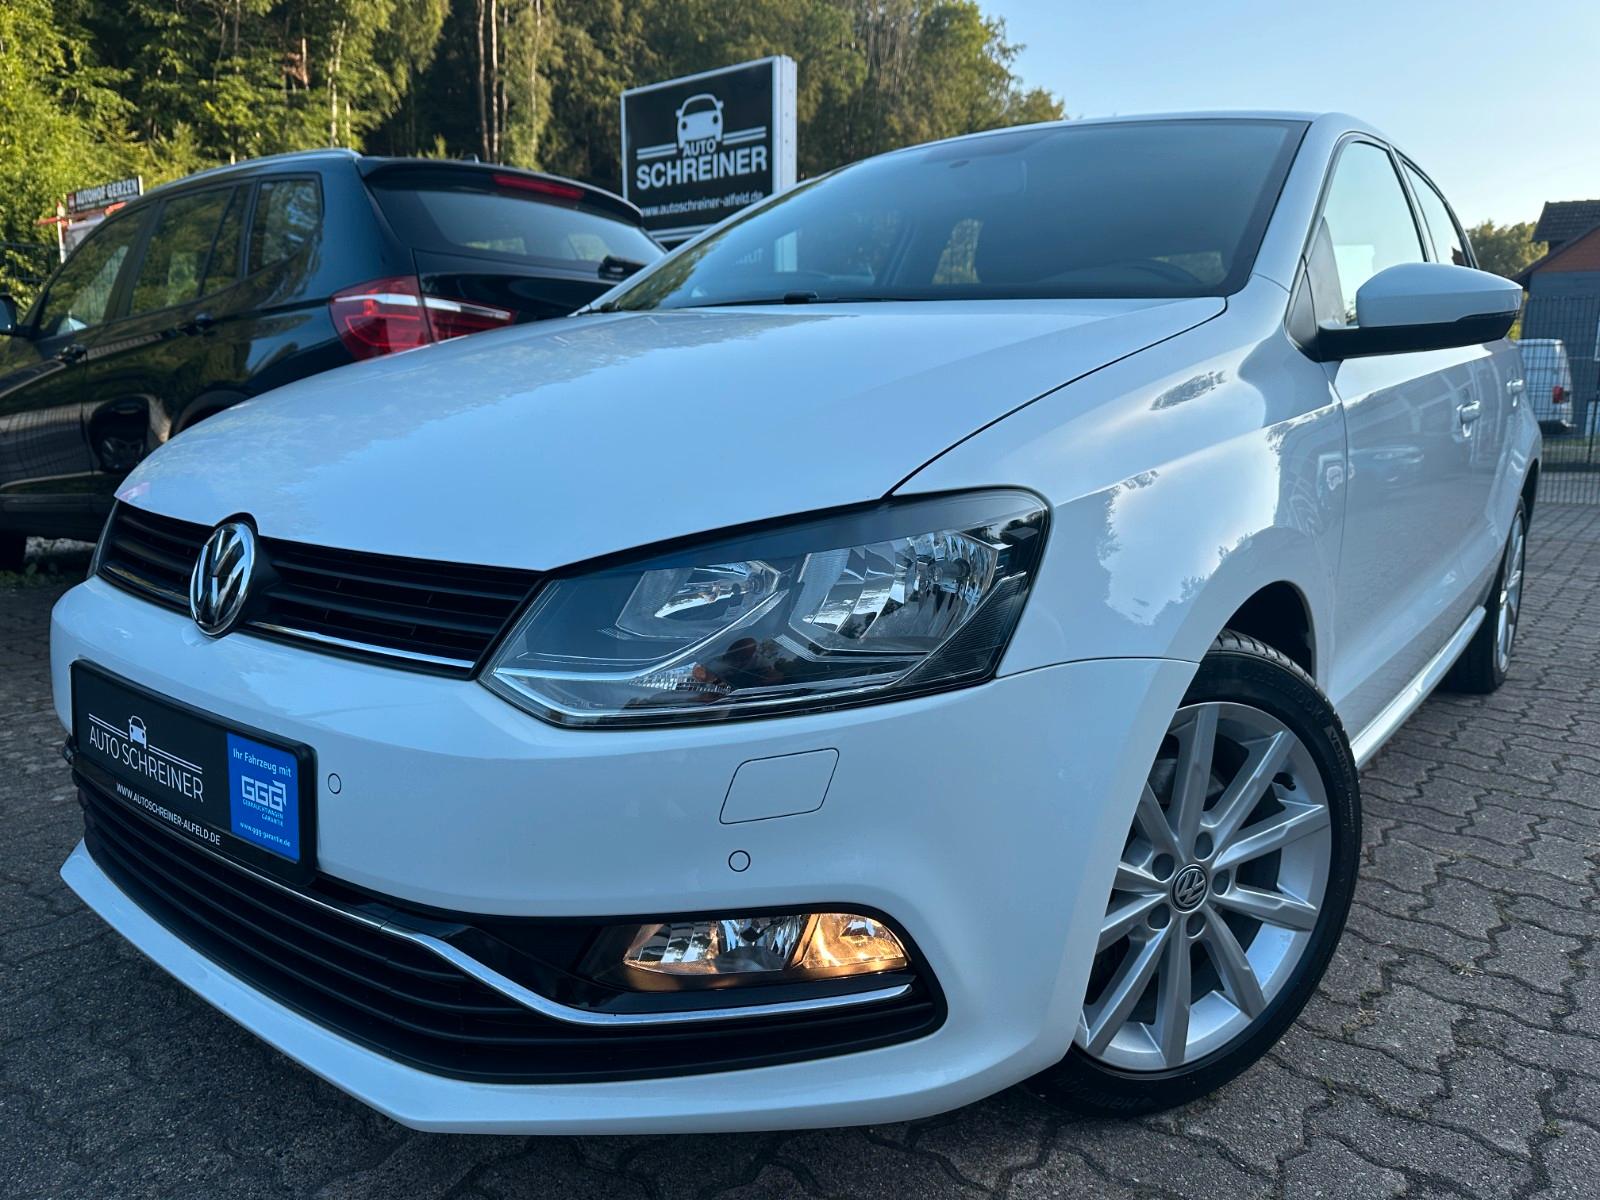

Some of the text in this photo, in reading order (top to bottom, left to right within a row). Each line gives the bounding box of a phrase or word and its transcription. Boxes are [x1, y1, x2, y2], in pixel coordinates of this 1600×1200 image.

[636, 145, 767, 190] SCHREINER
[683, 138, 716, 157] AUTO
[89, 726, 204, 803] AUTO SCHREINER
[233, 748, 292, 778] Ihr Fahrzeug mit
[116, 782, 221, 846] WWW.AUTOSCHREINER-ALFELD.DE
